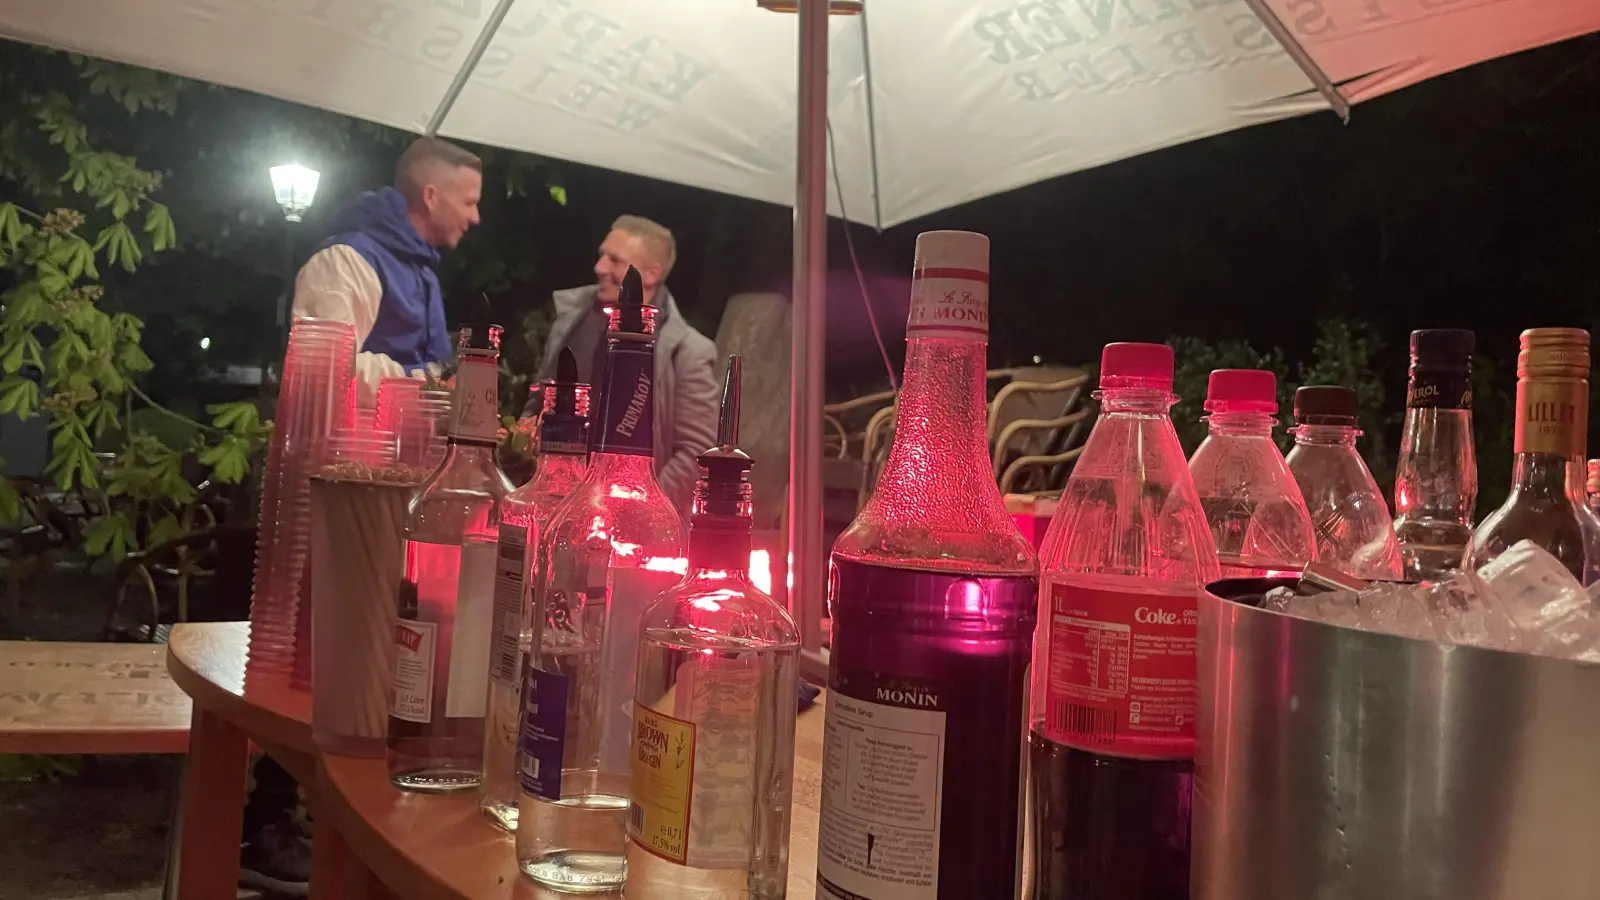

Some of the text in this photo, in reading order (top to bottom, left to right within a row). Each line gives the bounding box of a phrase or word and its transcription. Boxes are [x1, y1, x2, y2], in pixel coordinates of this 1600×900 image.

[933, 307, 988, 324] MONIN
[615, 372, 651, 438] PRIMAKOV
[1134, 606, 1177, 625] Coke
[876, 687, 939, 707] MONIN
